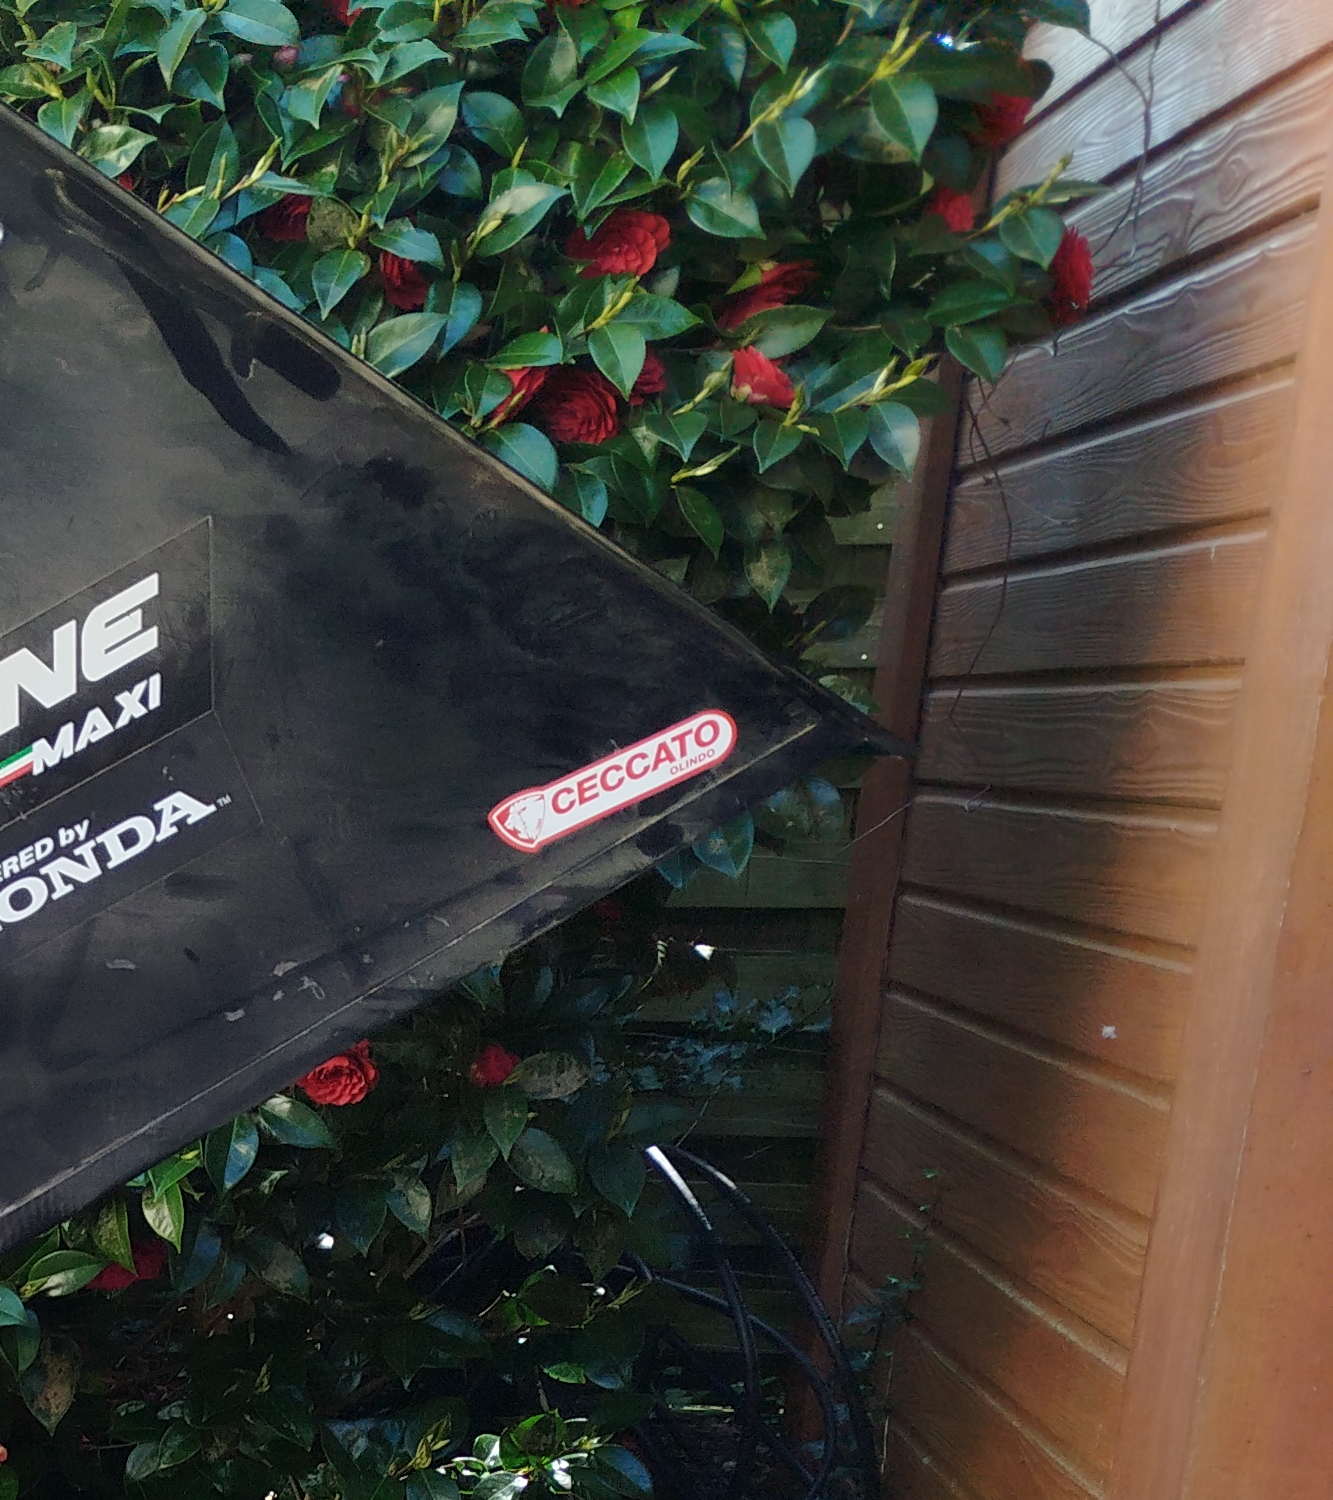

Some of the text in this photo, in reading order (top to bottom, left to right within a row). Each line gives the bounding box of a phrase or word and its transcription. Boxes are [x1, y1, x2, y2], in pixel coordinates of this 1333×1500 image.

[32, 672, 161, 776] MAXI
[550, 719, 721, 815] CECCATO
[669, 748, 716, 776] OLINDO
[58, 818, 90, 847] by
